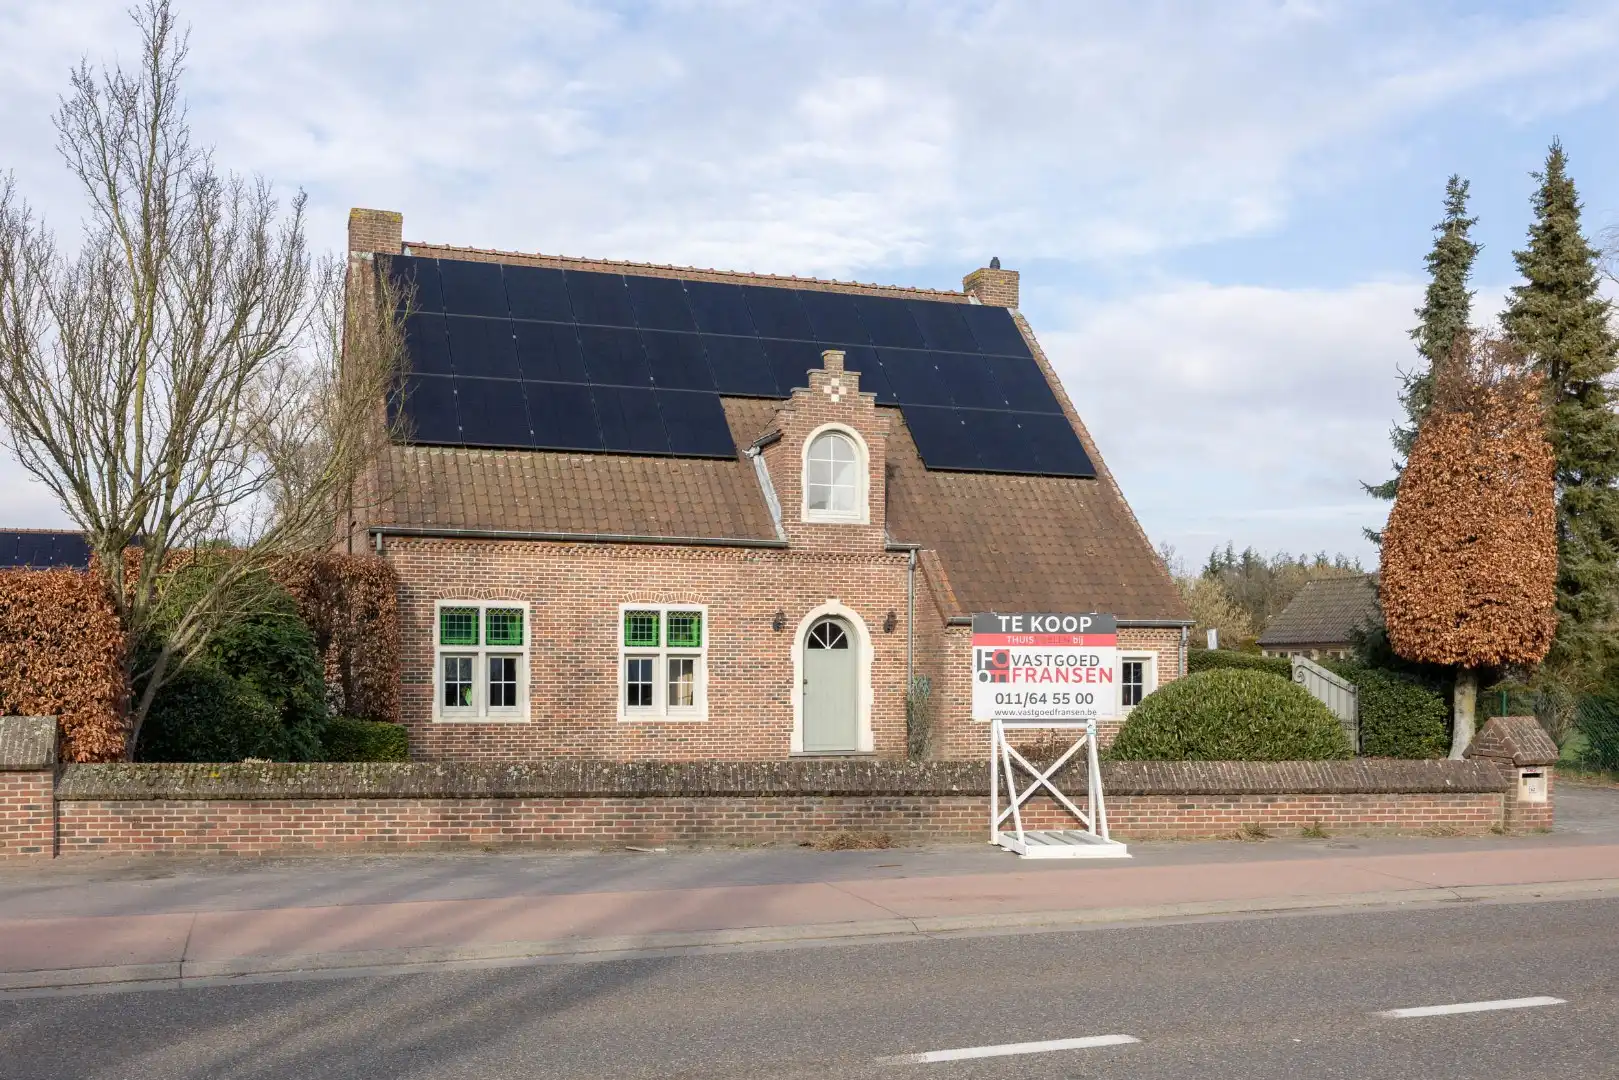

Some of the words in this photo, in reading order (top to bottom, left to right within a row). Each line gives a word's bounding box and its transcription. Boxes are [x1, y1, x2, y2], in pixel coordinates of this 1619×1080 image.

[997, 616, 1023, 633] TE
[1030, 616, 1092, 633] KOOP
[1073, 636, 1084, 646] bij
[1011, 655, 1100, 667] VASTGOED
[1012, 667, 1113, 684] FRANSEN
[995, 692, 1048, 708] 011/64
[1052, 693, 1070, 705] 55
[1075, 693, 1094, 705] 00
[994, 708, 1097, 717] www.vastgoedfransen.be
